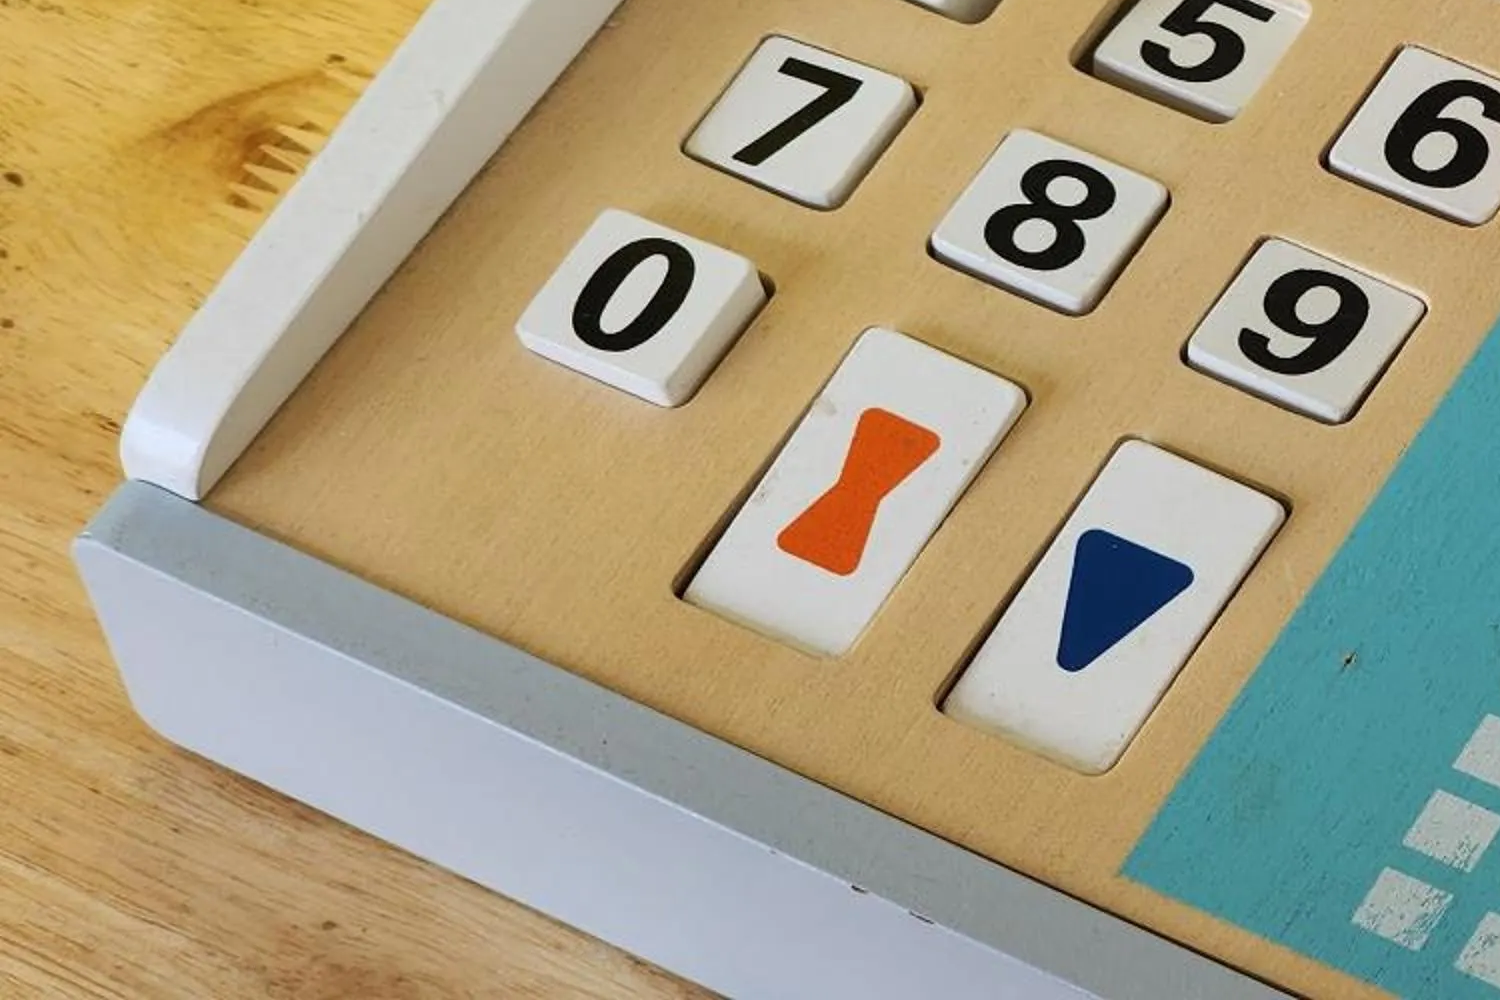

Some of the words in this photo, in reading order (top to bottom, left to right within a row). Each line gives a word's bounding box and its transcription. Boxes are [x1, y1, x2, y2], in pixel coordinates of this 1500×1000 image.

[571, 237, 695, 353] 0
[732, 57, 863, 167] 7
[984, 159, 1117, 271] 8
[1237, 268, 1370, 376] 9
